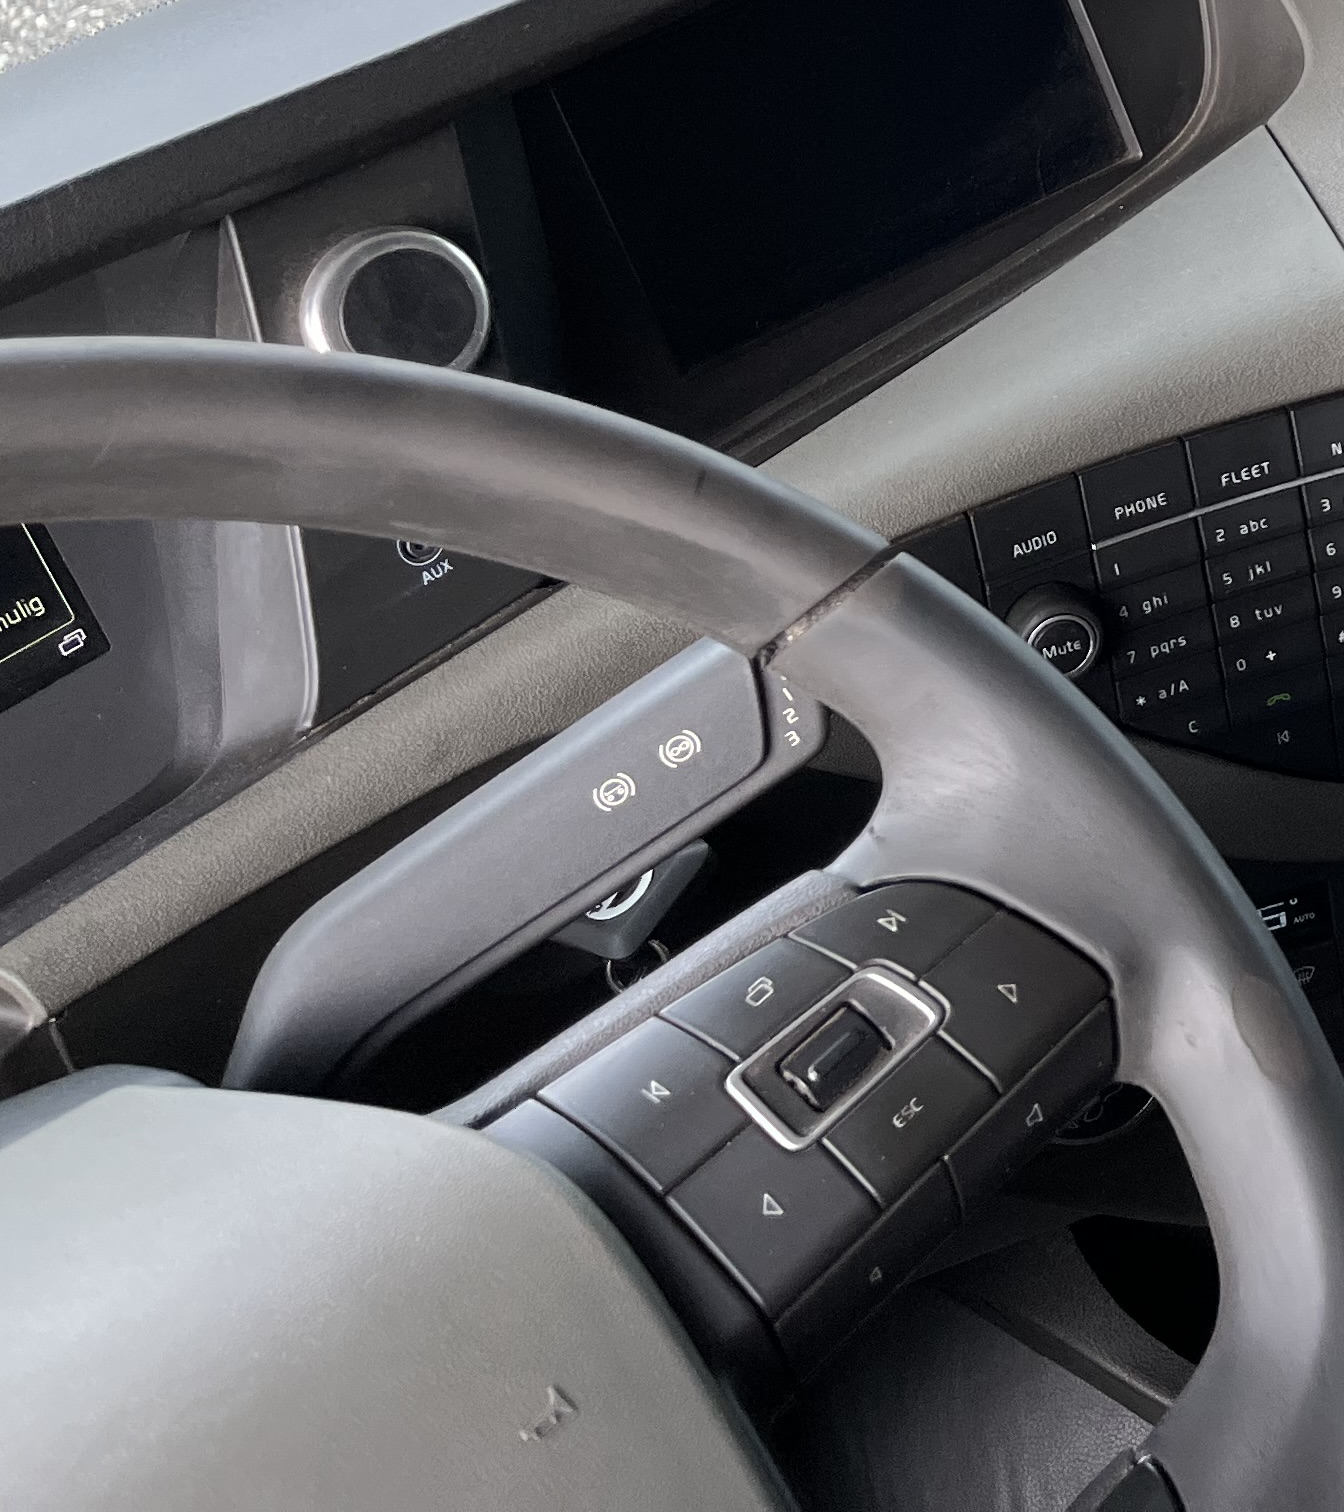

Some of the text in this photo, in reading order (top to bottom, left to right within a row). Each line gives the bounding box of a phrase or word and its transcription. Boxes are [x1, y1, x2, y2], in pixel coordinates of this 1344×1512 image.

[1220, 461, 1271, 487] FLEET
[1114, 492, 1168, 520] PHONE
[1320, 498, 1331, 513] 3
[1215, 518, 1269, 542] 2 abc
[1013, 530, 1057, 558] AUDIO
[1325, 543, 1336, 556] 6
[421, 558, 454, 586] AUX
[1222, 561, 1272, 586] 5 jkl
[1331, 585, 1342, 598] 9
[1119, 595, 1169, 618] 4 ghi
[1229, 604, 1282, 628] 8 tuv
[1042, 640, 1082, 660] Mute
[1126, 635, 1187, 664] 7 pqrs
[1158, 679, 1190, 700] a/A
[782, 707, 799, 724] 2
[1188, 720, 1200, 733] C
[783, 730, 801, 747] 3
[1293, 912, 1316, 925] AUTO
[892, 1097, 925, 1128] ESC
